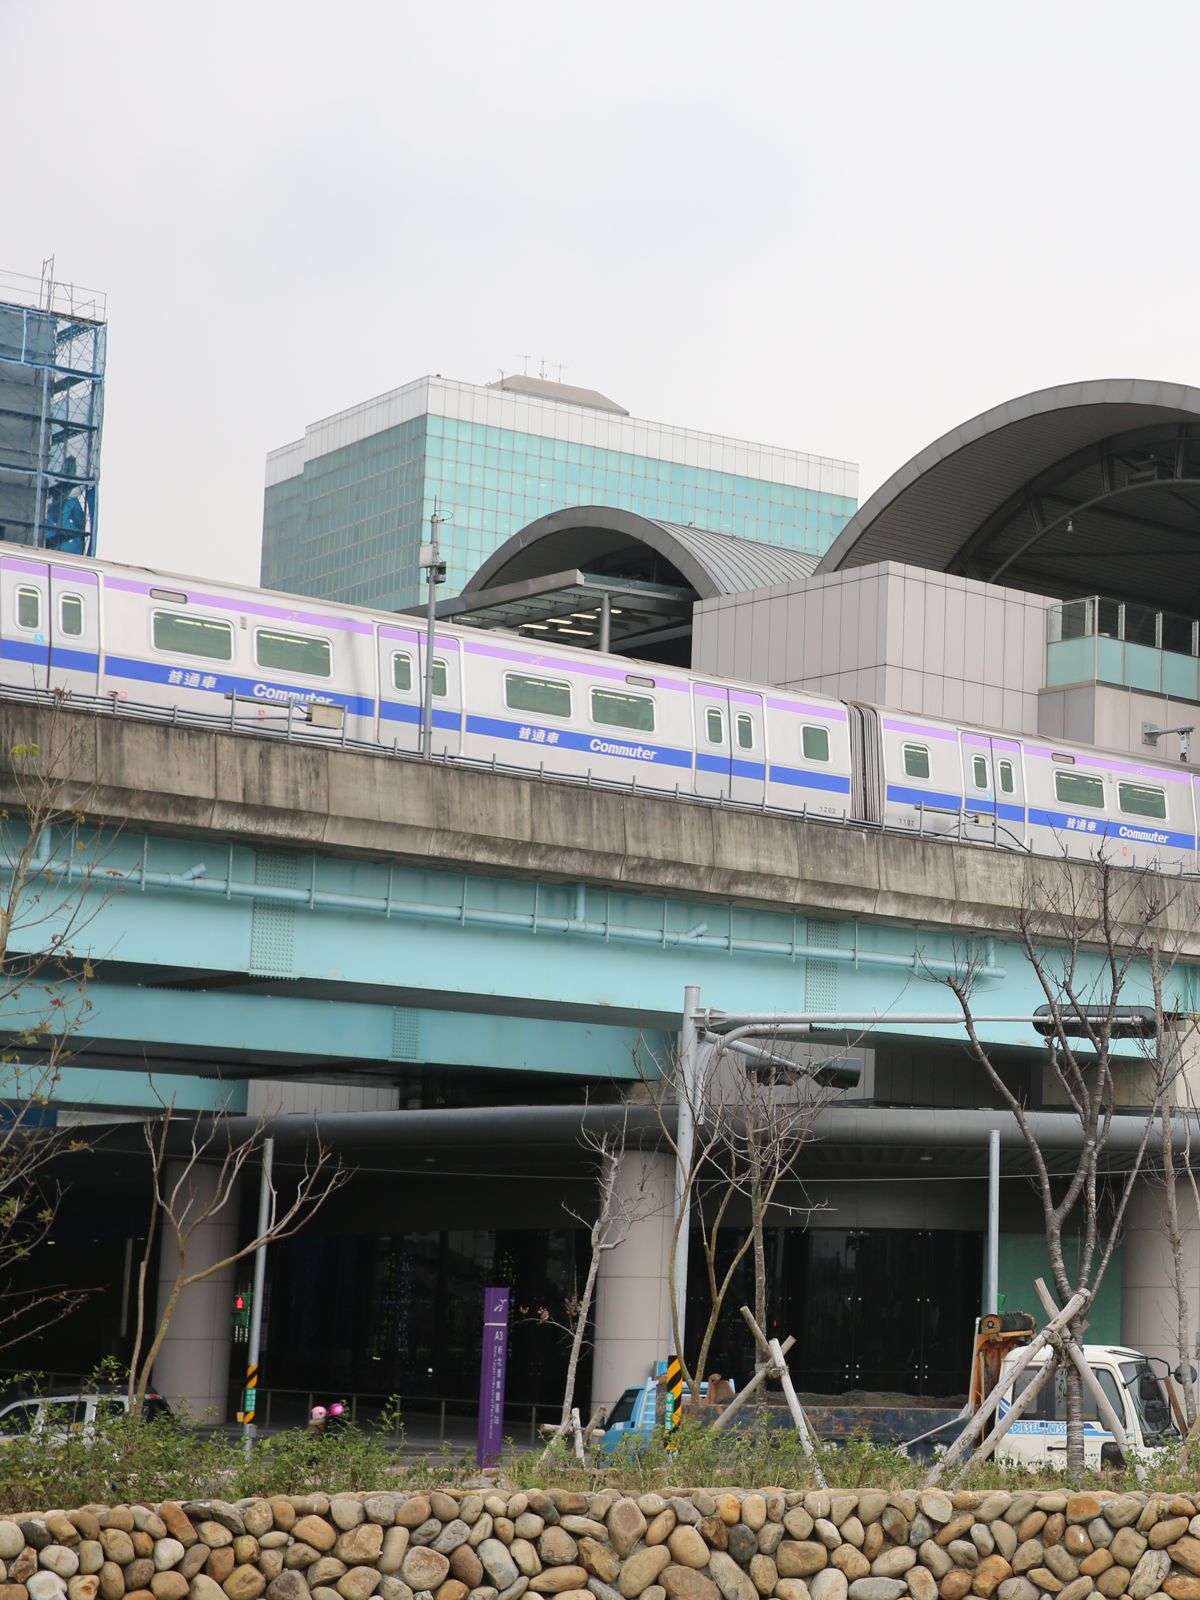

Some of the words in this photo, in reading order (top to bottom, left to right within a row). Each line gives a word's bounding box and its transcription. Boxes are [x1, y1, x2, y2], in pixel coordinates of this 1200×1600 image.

[167, 670, 218, 689] 普通車
[518, 726, 560, 744] 普通車
[589, 738, 657, 760] Commuter
[1066, 817, 1097, 832] 普通車
[1119, 826, 1169, 843] Commuter
[494, 1330, 504, 1341] A3
[1012, 1422, 1040, 1433] DIESEL
[1047, 1423, 1067, 1434] NISS
